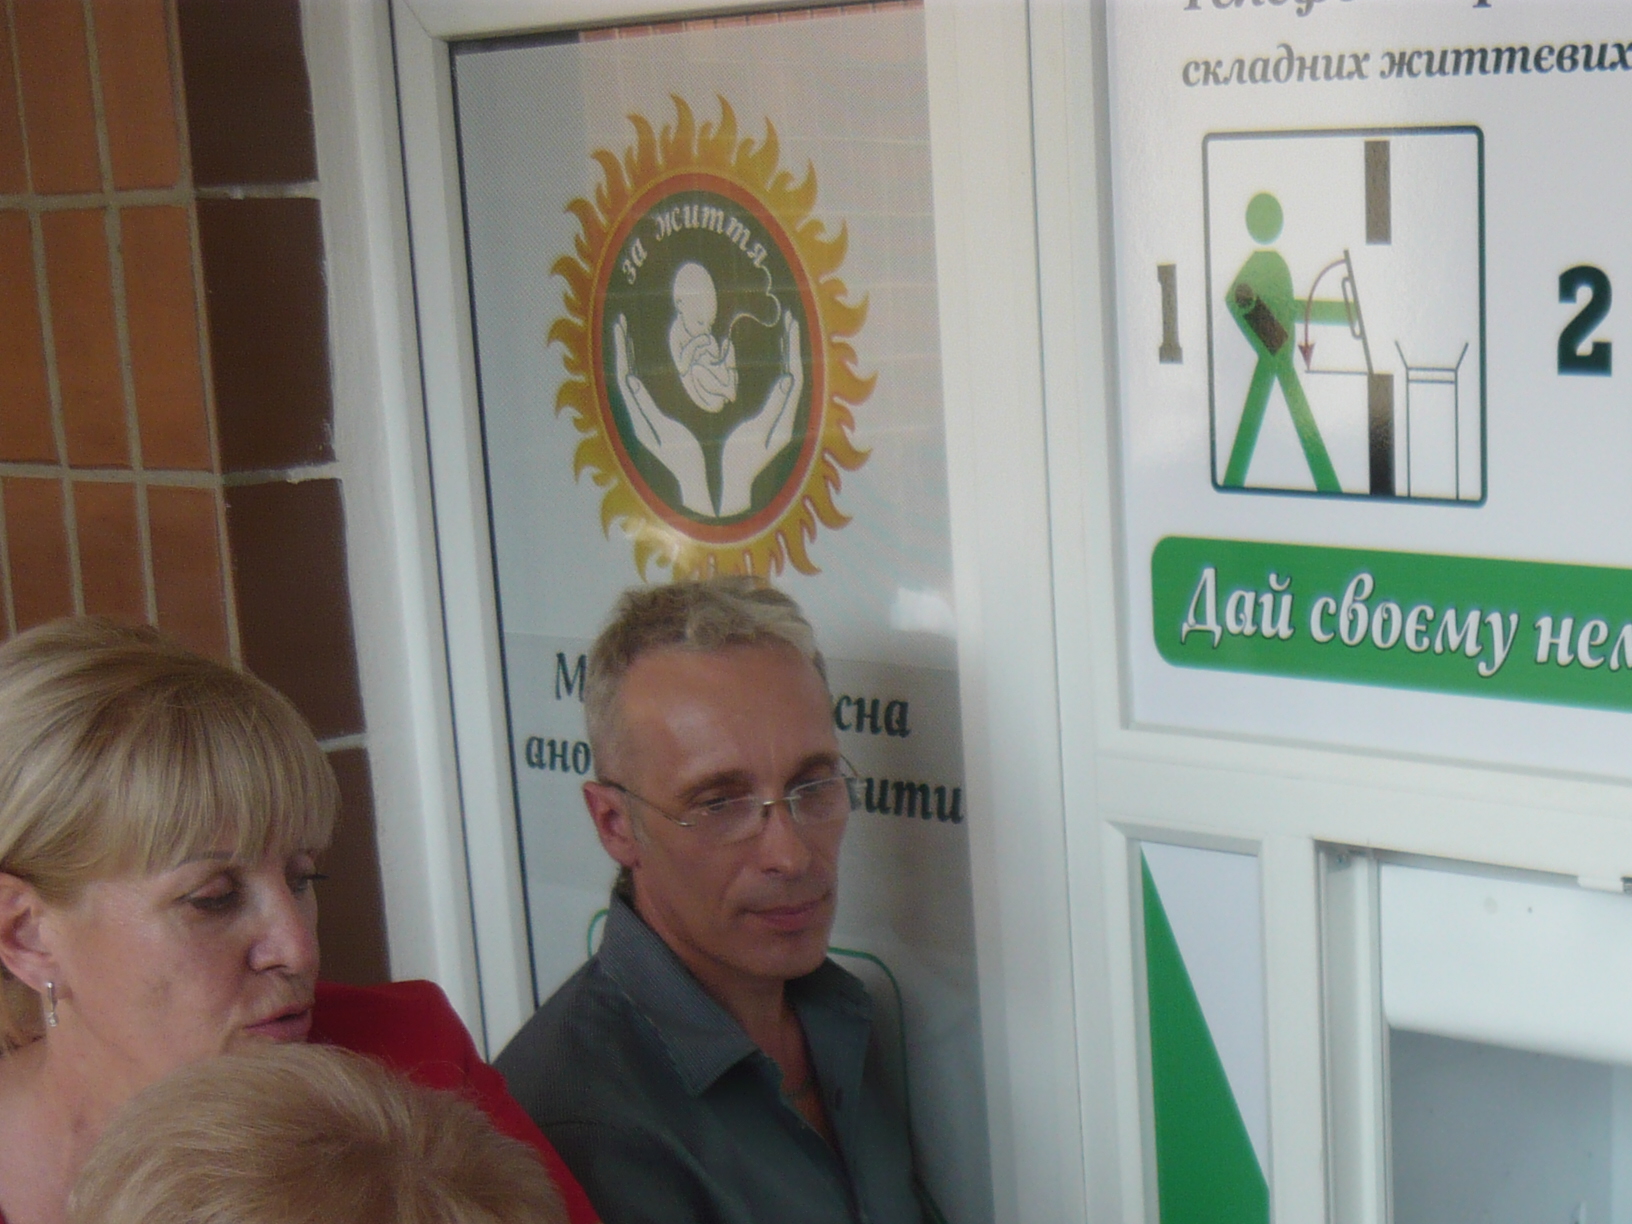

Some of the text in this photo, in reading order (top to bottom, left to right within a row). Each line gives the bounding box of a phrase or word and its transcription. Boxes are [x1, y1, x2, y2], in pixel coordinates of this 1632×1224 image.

[1181, 42, 1371, 88] складних
[621, 203, 769, 286] за життя
[1156, 263, 1184, 365] 1
[1556, 264, 1614, 378] 2
[1181, 566, 1295, 650] Дай
[1308, 571, 1519, 679] своєму
